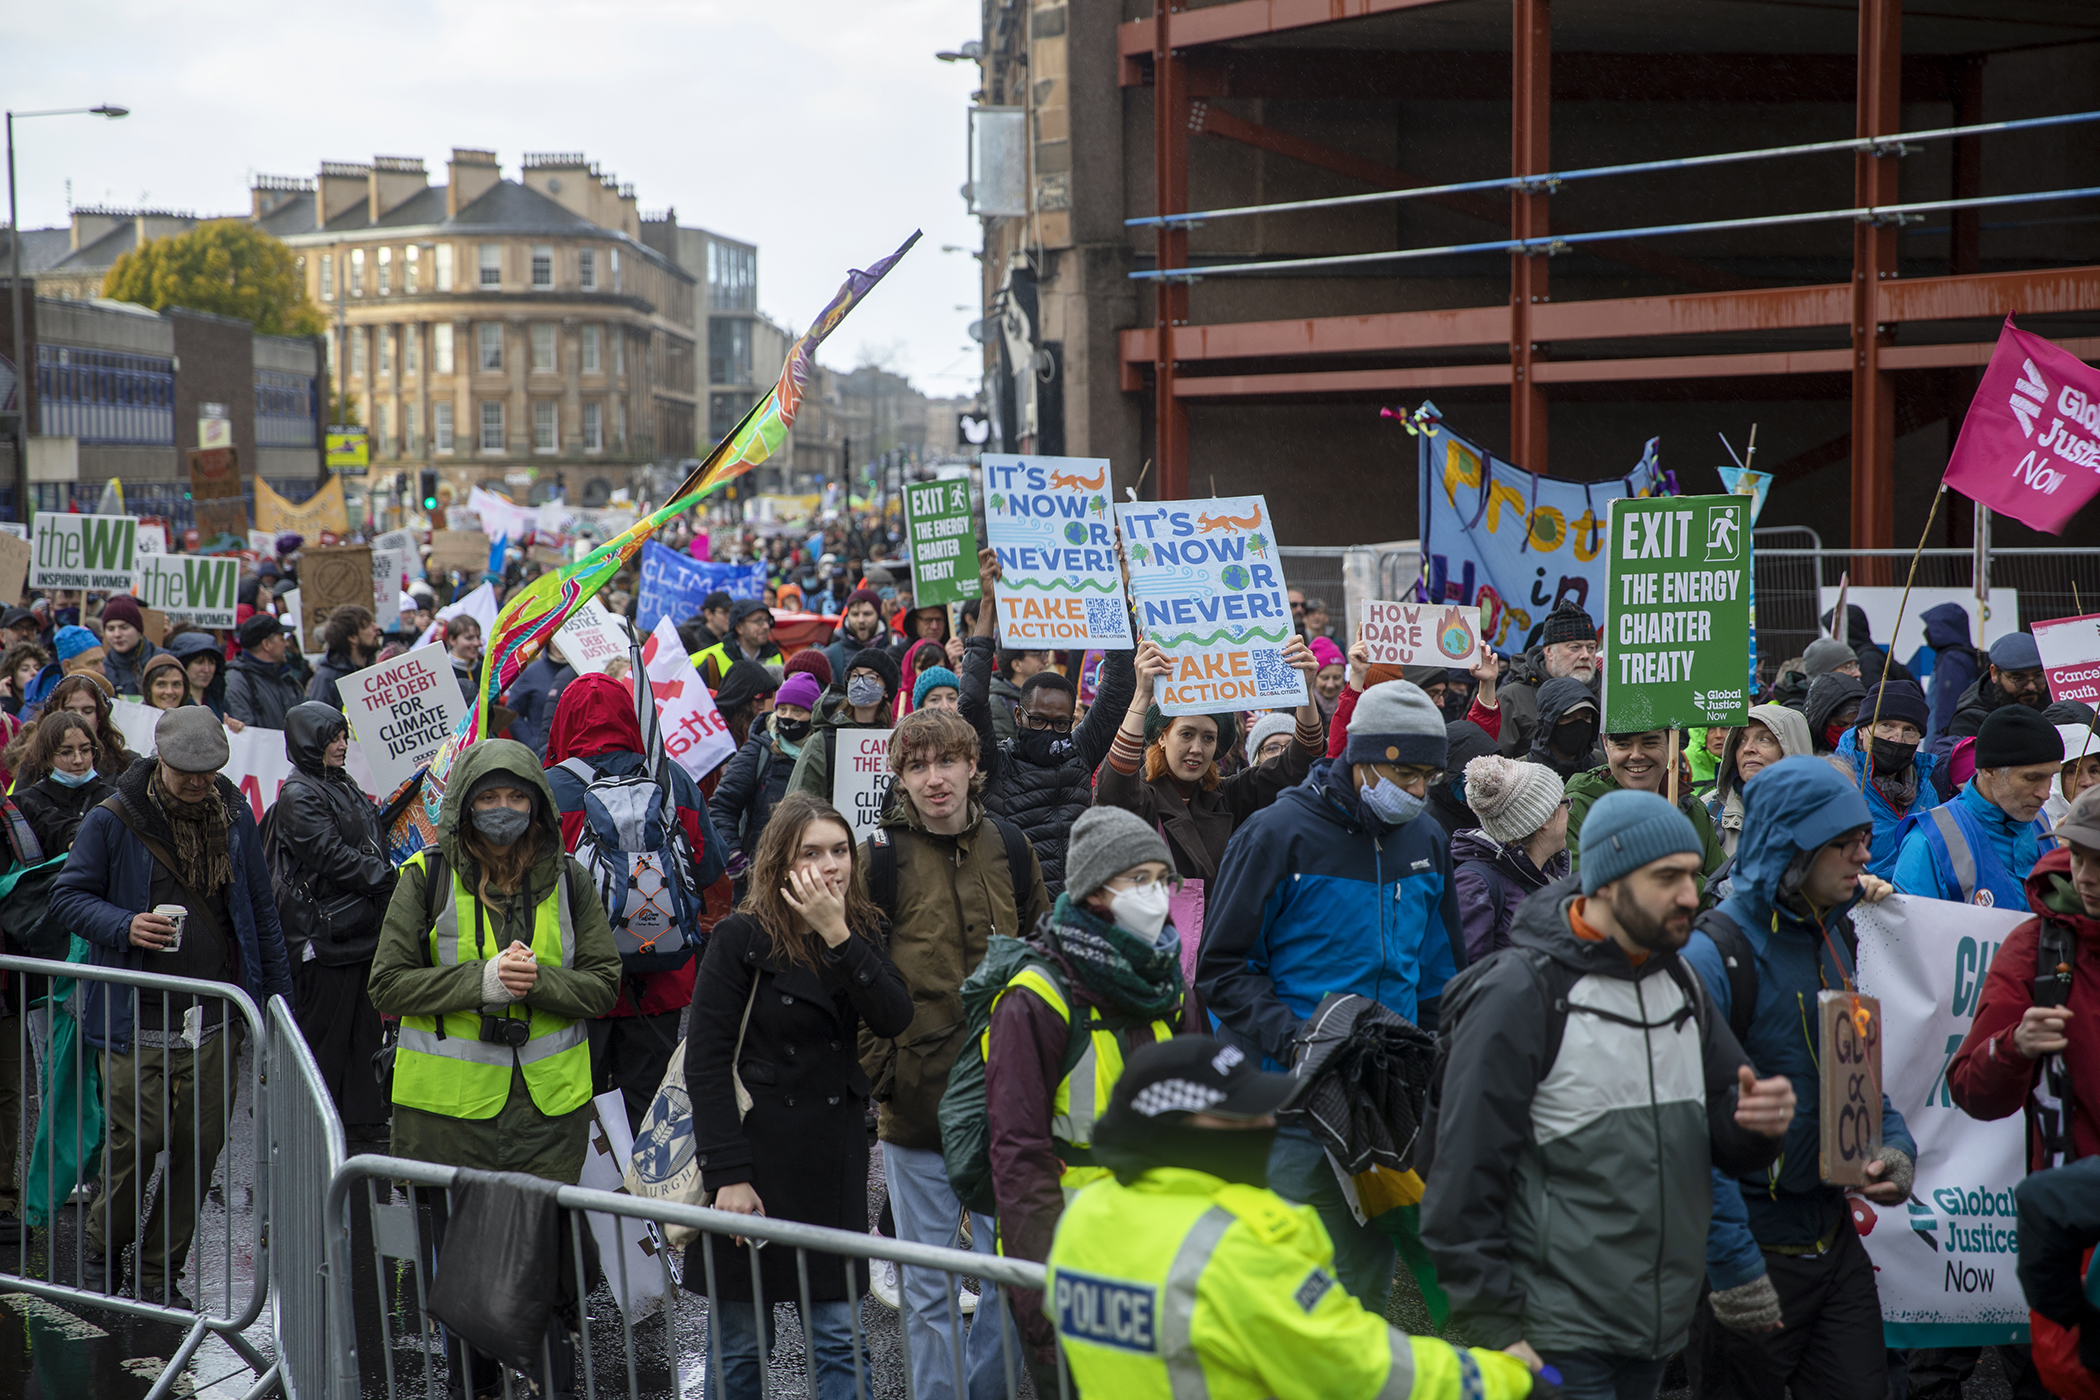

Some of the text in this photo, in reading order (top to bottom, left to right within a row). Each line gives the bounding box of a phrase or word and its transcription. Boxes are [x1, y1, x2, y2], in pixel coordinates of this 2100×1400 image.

[989, 461, 1047, 491] IT'S
[912, 486, 944, 517] EXIT
[1009, 494, 1088, 518] NOW
[914, 516, 969, 540] THE ENERGY
[1124, 507, 1194, 539] IT'S
[1622, 511, 1693, 560] EXIT
[917, 538, 960, 561] CHARTER
[996, 547, 1115, 572] NEVER!
[1153, 536, 1245, 566] NOW
[37, 573, 131, 588] INSPIRING WOMEN
[919, 560, 955, 582] TREATY
[1621, 570, 1741, 605] THE ENERGY
[196, 612, 233, 625] WOMEN
[1001, 598, 1085, 620] TAKE
[1144, 591, 1284, 626] NEVER!
[1370, 605, 1421, 624] HOW
[562, 615, 602, 633] JUSTICE
[1008, 623, 1088, 638] ACTION
[1365, 624, 1422, 647] DARE
[1619, 610, 1711, 645] CHARTER
[580, 634, 607, 647] DEBT
[581, 642, 622, 661] JUSTICE
[1371, 644, 1414, 663] YOU
[364, 660, 428, 693] CANCEL
[1164, 651, 1252, 682] TAKE
[1619, 650, 1695, 684] TREATY
[2053, 666, 2100, 684] Cance
[362, 671, 437, 711] THE DEBT
[1163, 680, 1257, 704] ACTION
[1707, 689, 1741, 700] Global
[2058, 685, 2098, 700] south
[390, 696, 424, 720] FOR
[1706, 700, 1741, 710] Justice
[1707, 711, 1727, 721] Now
[380, 704, 448, 741] CLIMATE
[388, 722, 451, 760] JUSTICE
[860, 739, 890, 755] CAN
[853, 757, 882, 772] THE
[873, 775, 892, 789] FO
[856, 809, 881, 827] JUS
[1933, 1185, 2018, 1217] Global
[1944, 1221, 2019, 1254] Justice
[1944, 1260, 1994, 1293] Now
[1057, 1278, 1151, 1345] POLICE
